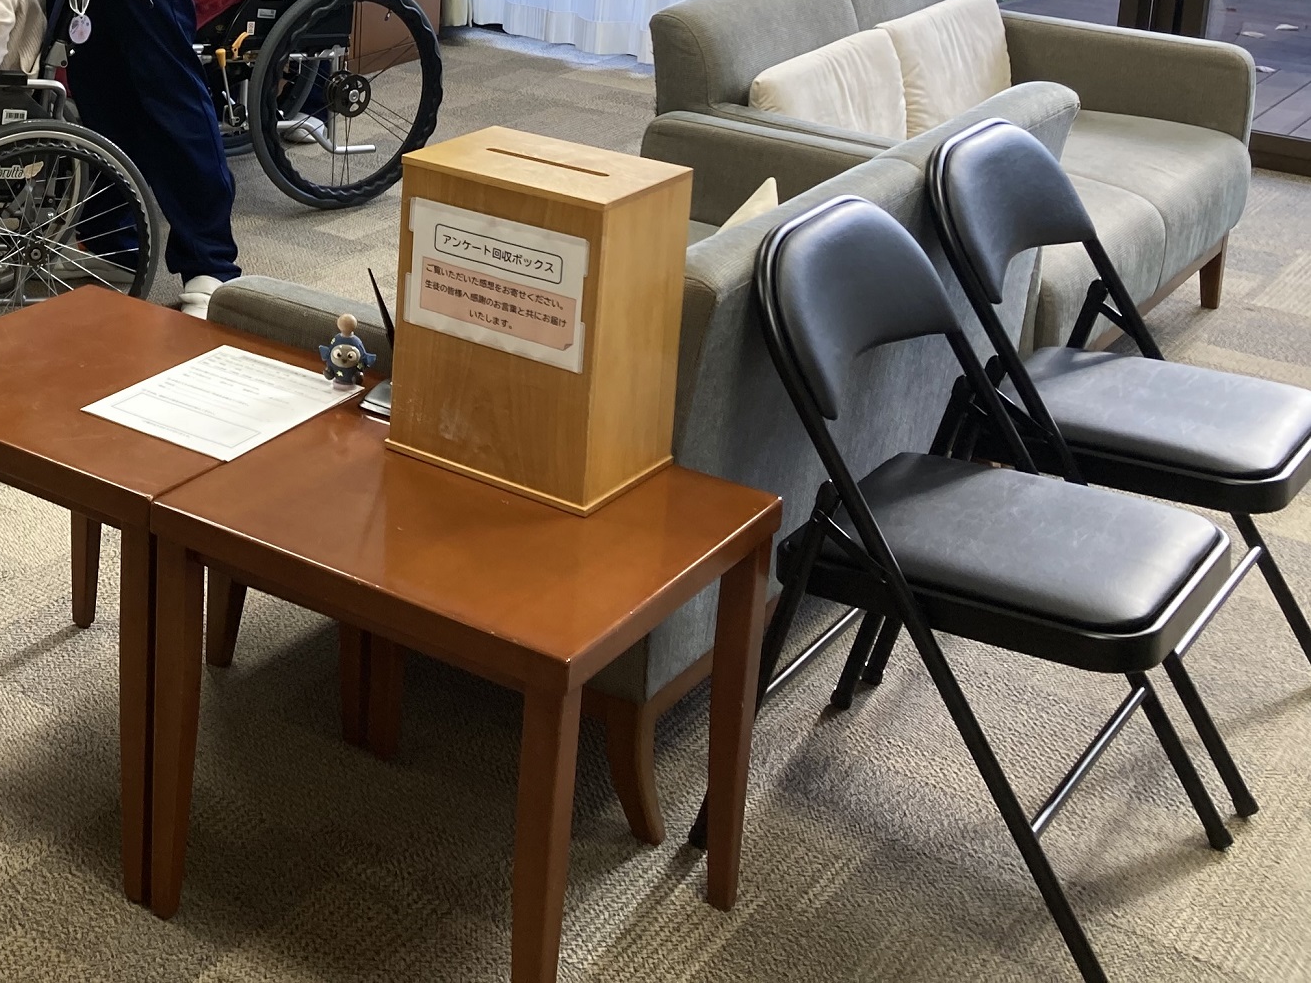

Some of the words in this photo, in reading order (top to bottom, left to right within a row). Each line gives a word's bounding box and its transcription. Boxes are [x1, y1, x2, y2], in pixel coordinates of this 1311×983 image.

[442, 234, 555, 274] アンケート回収ボックス
[424, 279, 568, 328] 生徒の皆様へ感謝のお言葉と共にお届け
[425, 263, 564, 311] ご覧いただいた感想をお寄せください。
[469, 309, 514, 330] いたします。
